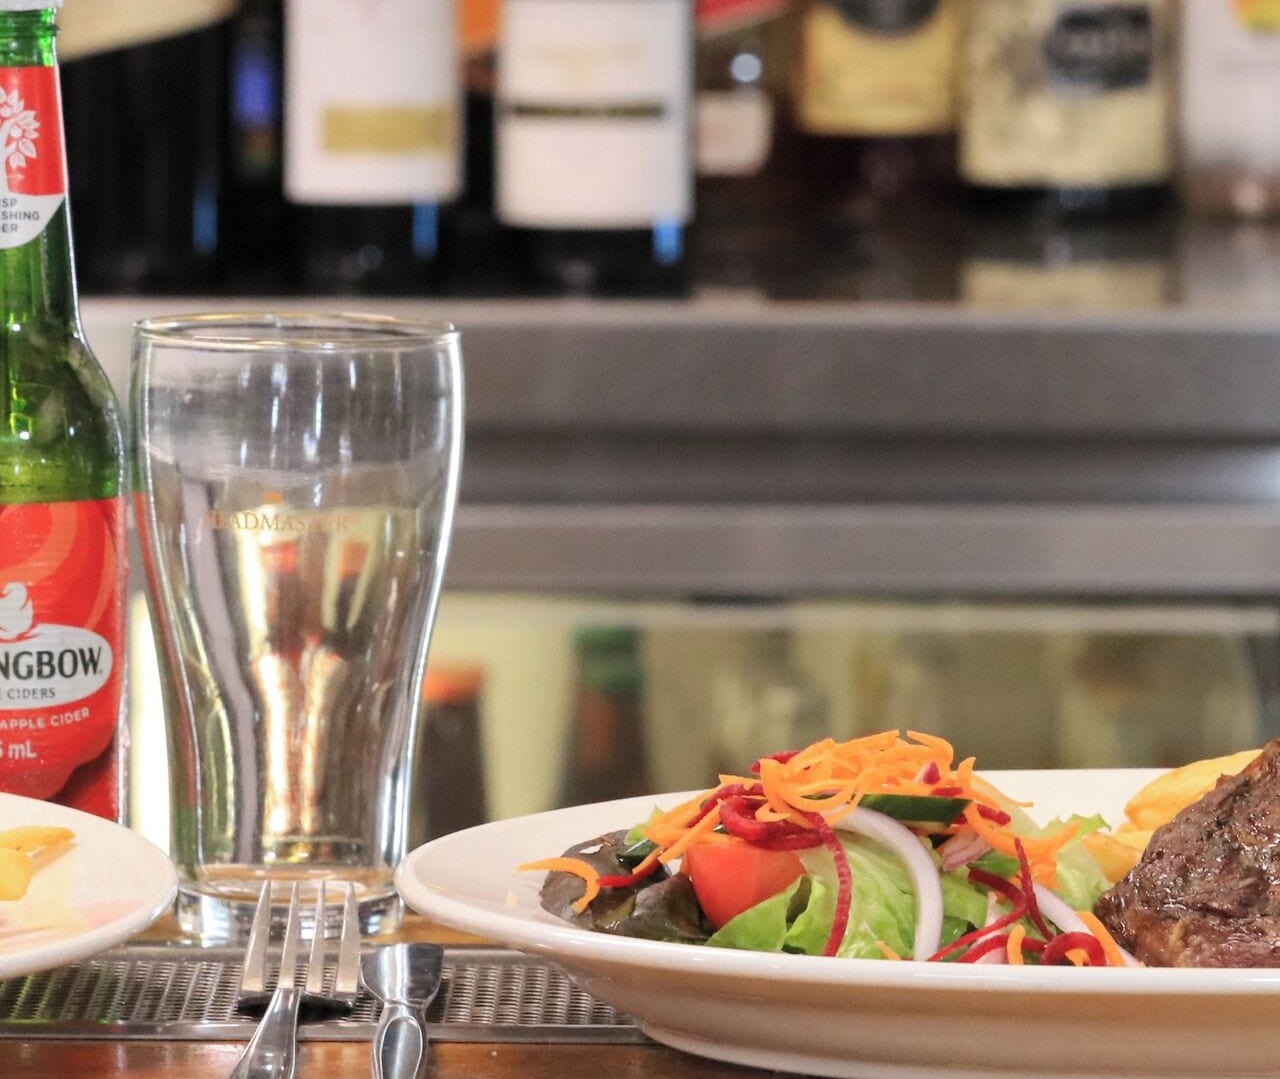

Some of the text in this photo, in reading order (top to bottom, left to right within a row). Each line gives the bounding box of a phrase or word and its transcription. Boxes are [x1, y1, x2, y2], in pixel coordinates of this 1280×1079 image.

[7, 687, 55, 700] CIDERS
[50, 707, 90, 724] CIDER
[8, 740, 37, 759] mL
